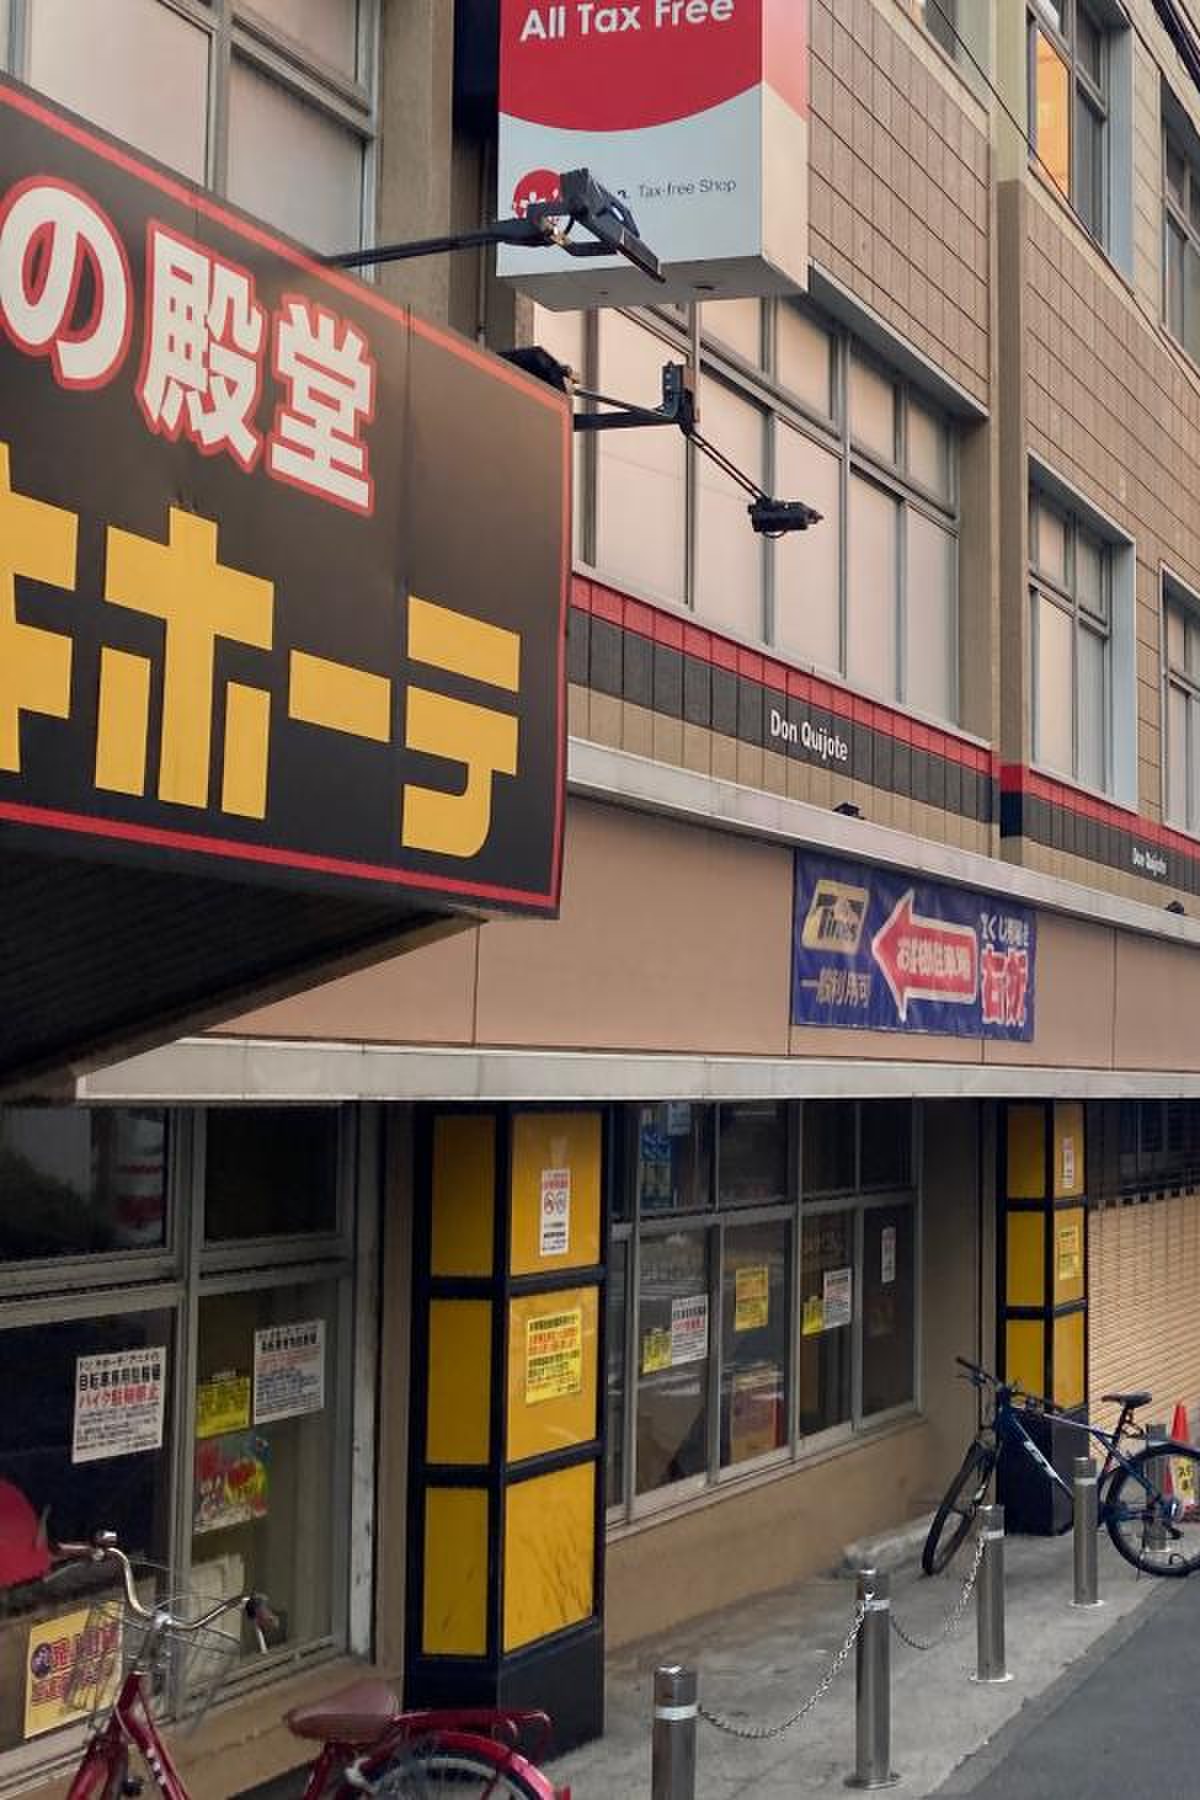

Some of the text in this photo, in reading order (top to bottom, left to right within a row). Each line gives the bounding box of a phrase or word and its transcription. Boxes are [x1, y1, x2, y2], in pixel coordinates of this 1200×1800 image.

[520, 0, 734, 41] All Tax Free
[639, 183, 695, 198] Tax-free
[699, 180, 737, 195] Shop
[0, 182, 375, 513] の殿堂
[770, 709, 848, 761] Don Quijote
[816, 905, 858, 943] Times
